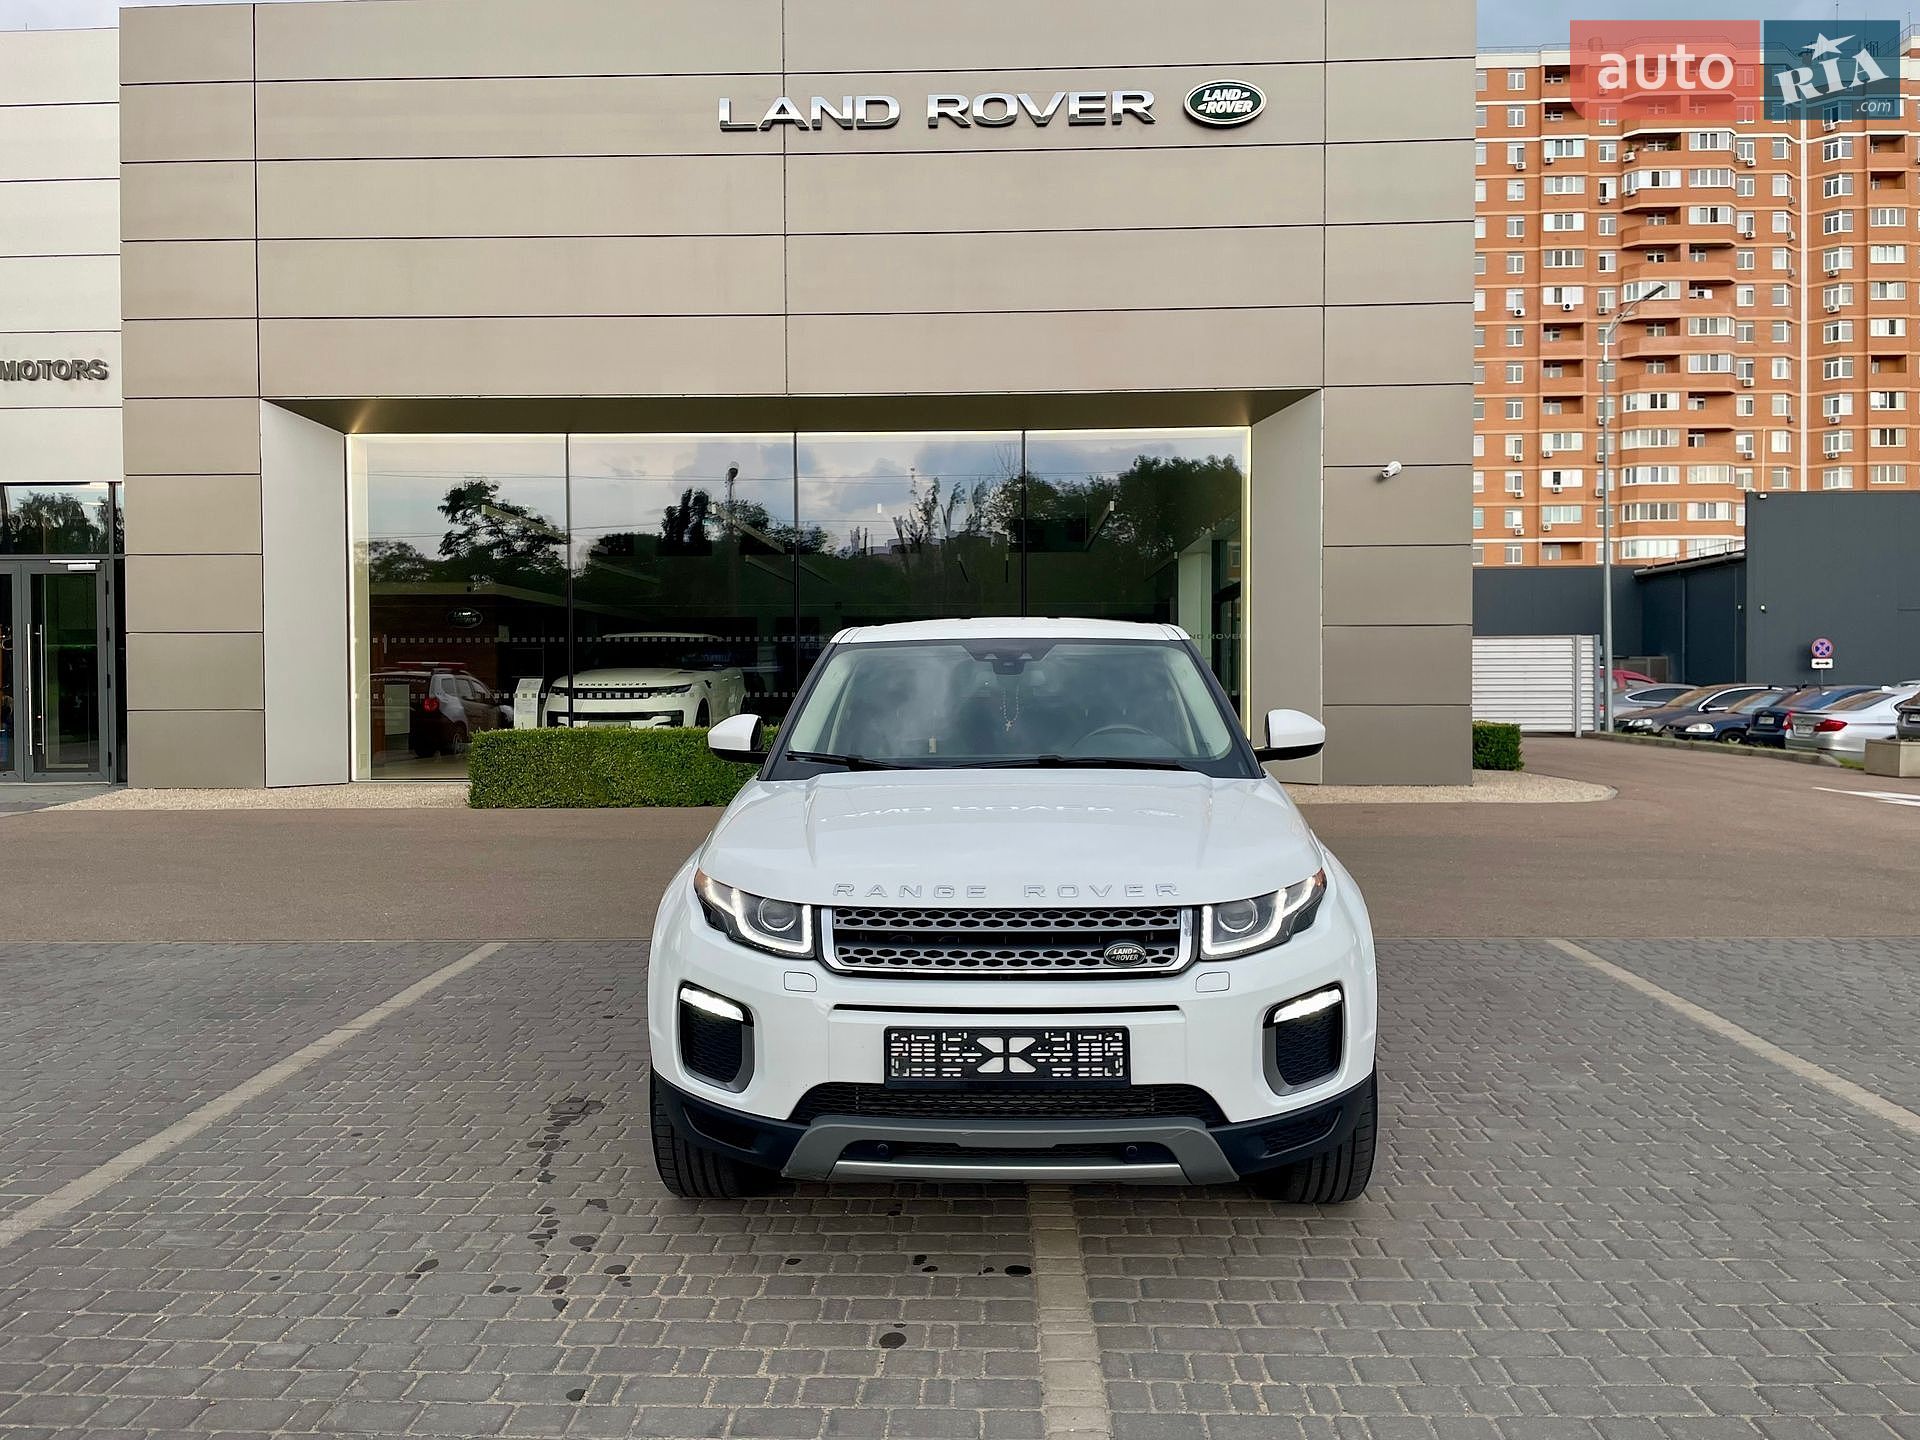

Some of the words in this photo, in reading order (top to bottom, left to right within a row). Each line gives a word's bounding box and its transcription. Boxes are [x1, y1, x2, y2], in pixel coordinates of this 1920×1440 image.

[1202, 89, 1242, 101] LAND
[718, 96, 901, 131] LAND
[927, 90, 1157, 128] ROVER
[1205, 100, 1254, 113] ROVER
[0, 359, 109, 381] MOTORS
[832, 883, 987, 899] RANGE
[1023, 883, 1180, 898] ROVER
